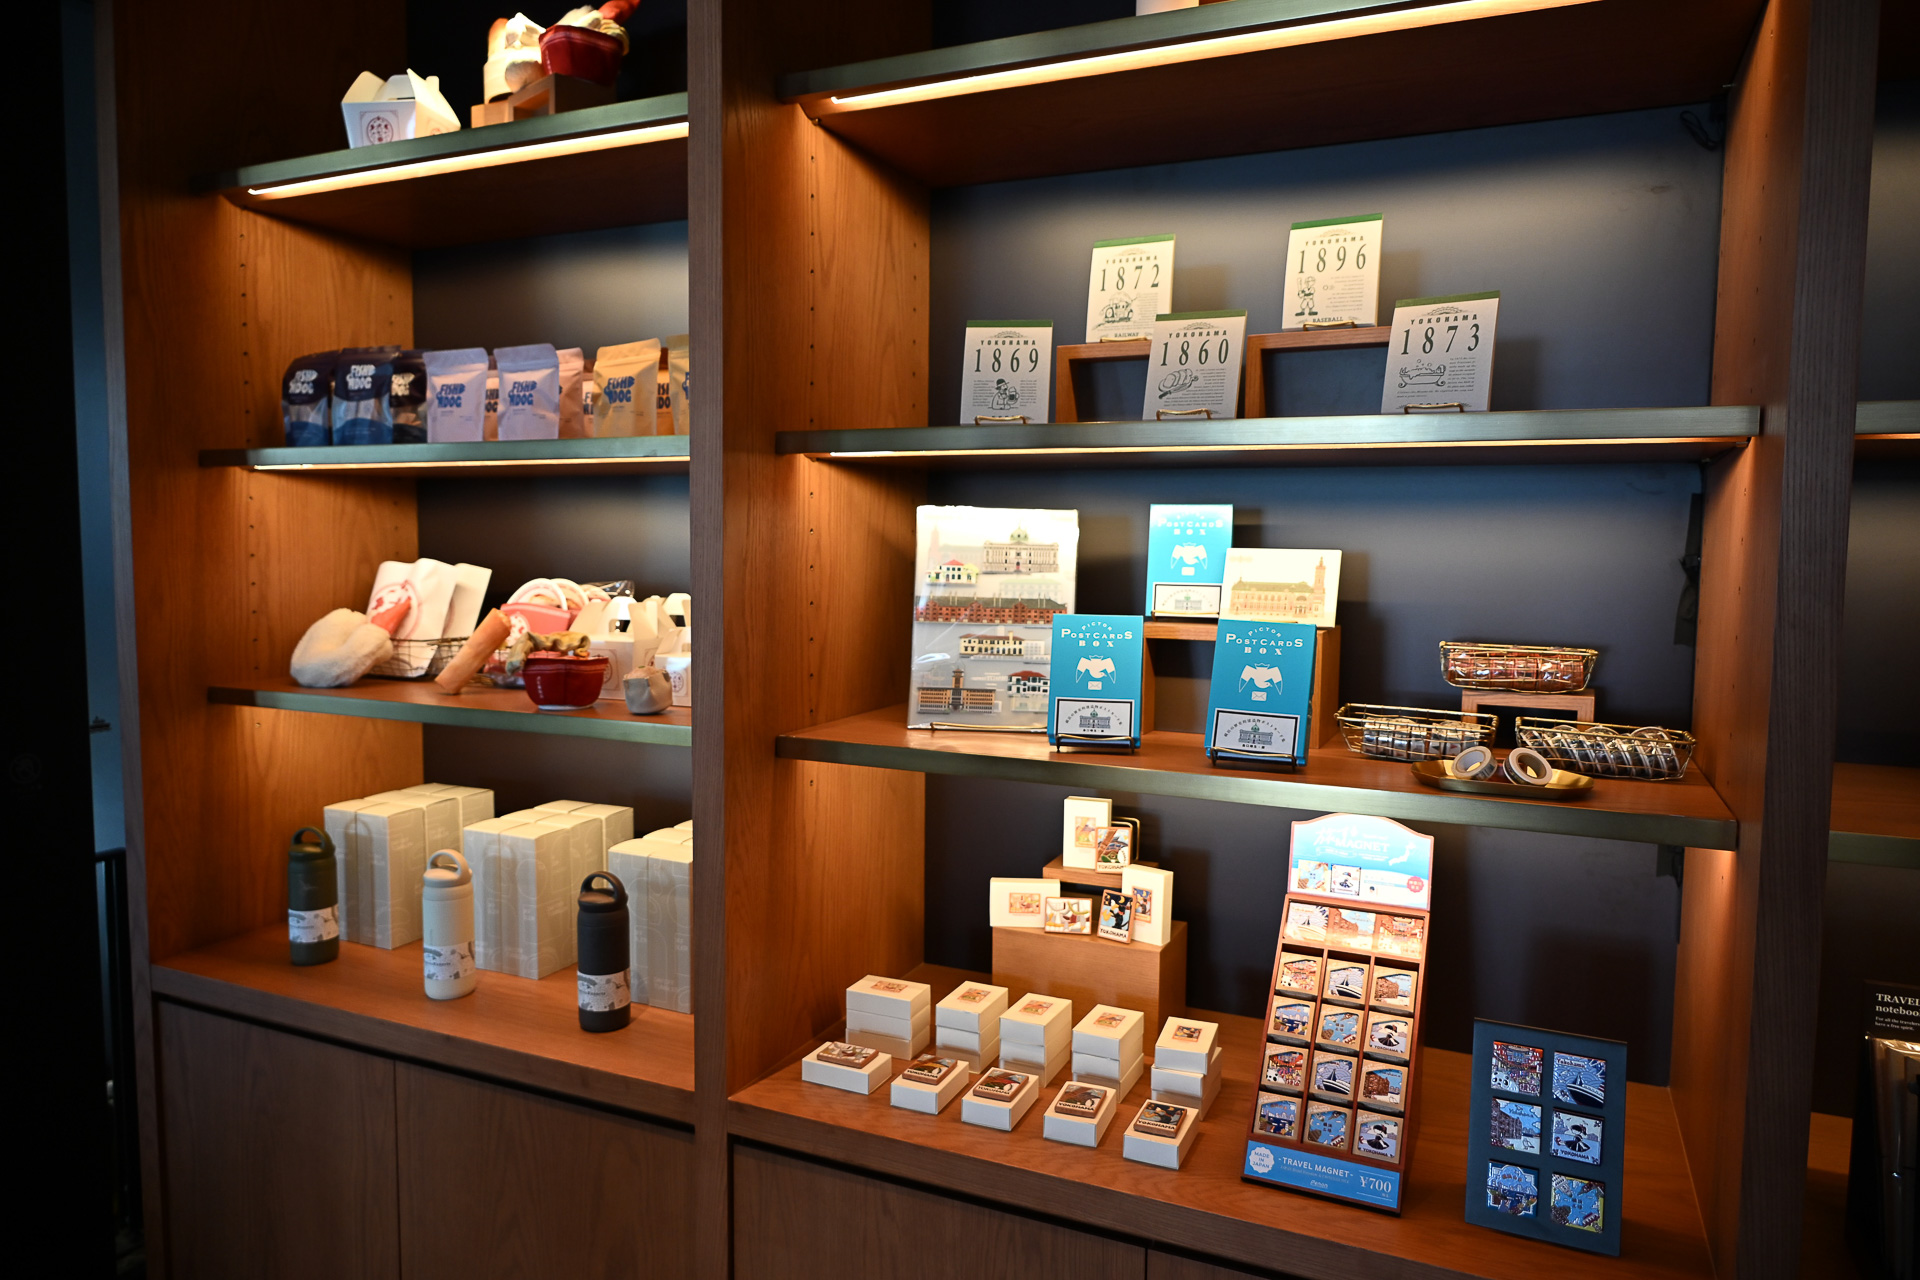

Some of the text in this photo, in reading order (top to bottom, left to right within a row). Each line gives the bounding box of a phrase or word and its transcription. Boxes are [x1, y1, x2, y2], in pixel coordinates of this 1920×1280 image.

[1306, 236, 1364, 246] YOKOHAMA
[1106, 255, 1157, 264] YOKOHAMA
[1298, 244, 1367, 274] 1896
[1100, 264, 1160, 291] 1872
[1411, 314, 1477, 325] YOKOHAMA
[1169, 330, 1227, 338] YOKOHAMA
[1401, 323, 1480, 355] 1873
[1161, 338, 1229, 366] 1860
[974, 348, 1039, 373] 1869
[1081, 621, 1113, 631] PICTOR
[1248, 626, 1282, 638] PICTOR
[1061, 628, 1133, 640] POSTCARDS
[1225, 633, 1304, 648] POSTCARDS
[1244, 646, 1283, 655] BOX
[1335, 838, 1390, 852] MAGNET
[1100, 928, 1127, 938] YOKOHAMA
[1875, 993, 1920, 1006] TRAVEL
[1875, 1005, 1920, 1017] noteboo
[1374, 1045, 1399, 1053] YOKOHAMA
[1058, 1102, 1095, 1111] YOKOHAMA
[1138, 1120, 1176, 1130] YOKOHAMA
[1254, 1150, 1270, 1159] MADE
[1363, 1148, 1390, 1157] YOKOHAMA
[1560, 1149, 1590, 1161] YOKOHAMA
[1252, 1161, 1270, 1169] JAPAN
[1282, 1156, 1313, 1171] TRAVEL
[1314, 1163, 1349, 1178] MAGNET
[1360, 1175, 1392, 1193] ¥700
